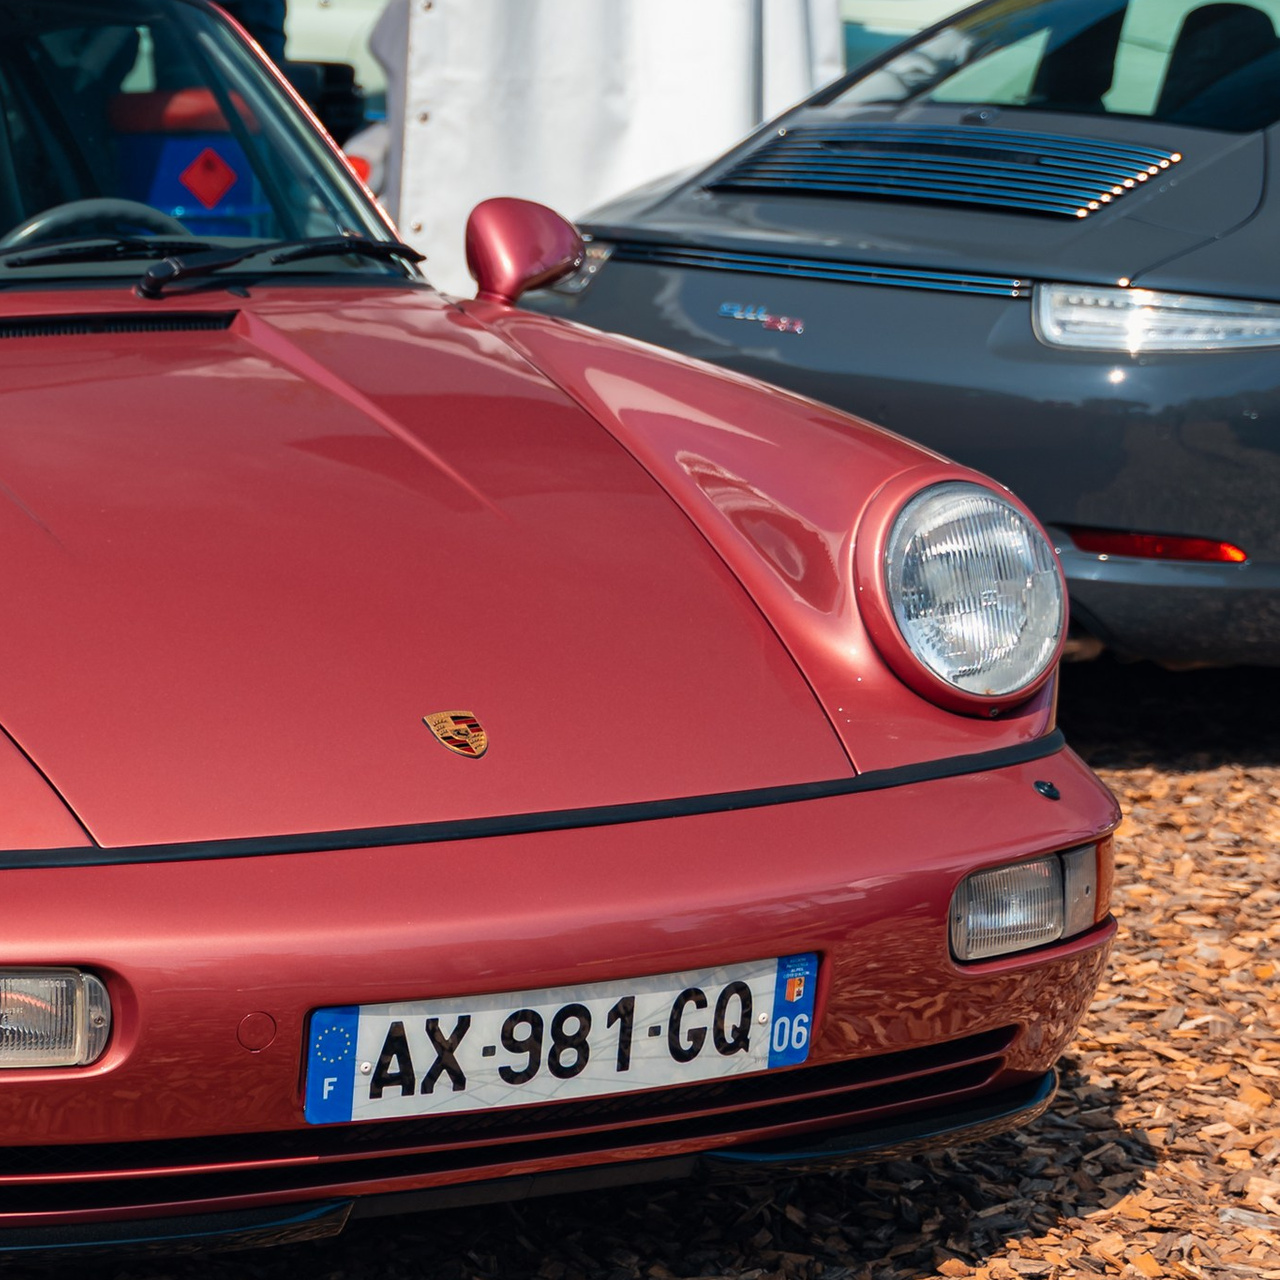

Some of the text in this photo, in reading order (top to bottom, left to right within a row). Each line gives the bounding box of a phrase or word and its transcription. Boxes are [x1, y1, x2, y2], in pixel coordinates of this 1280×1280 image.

[323, 980, 809, 1100] F AX-981-GQ 06
